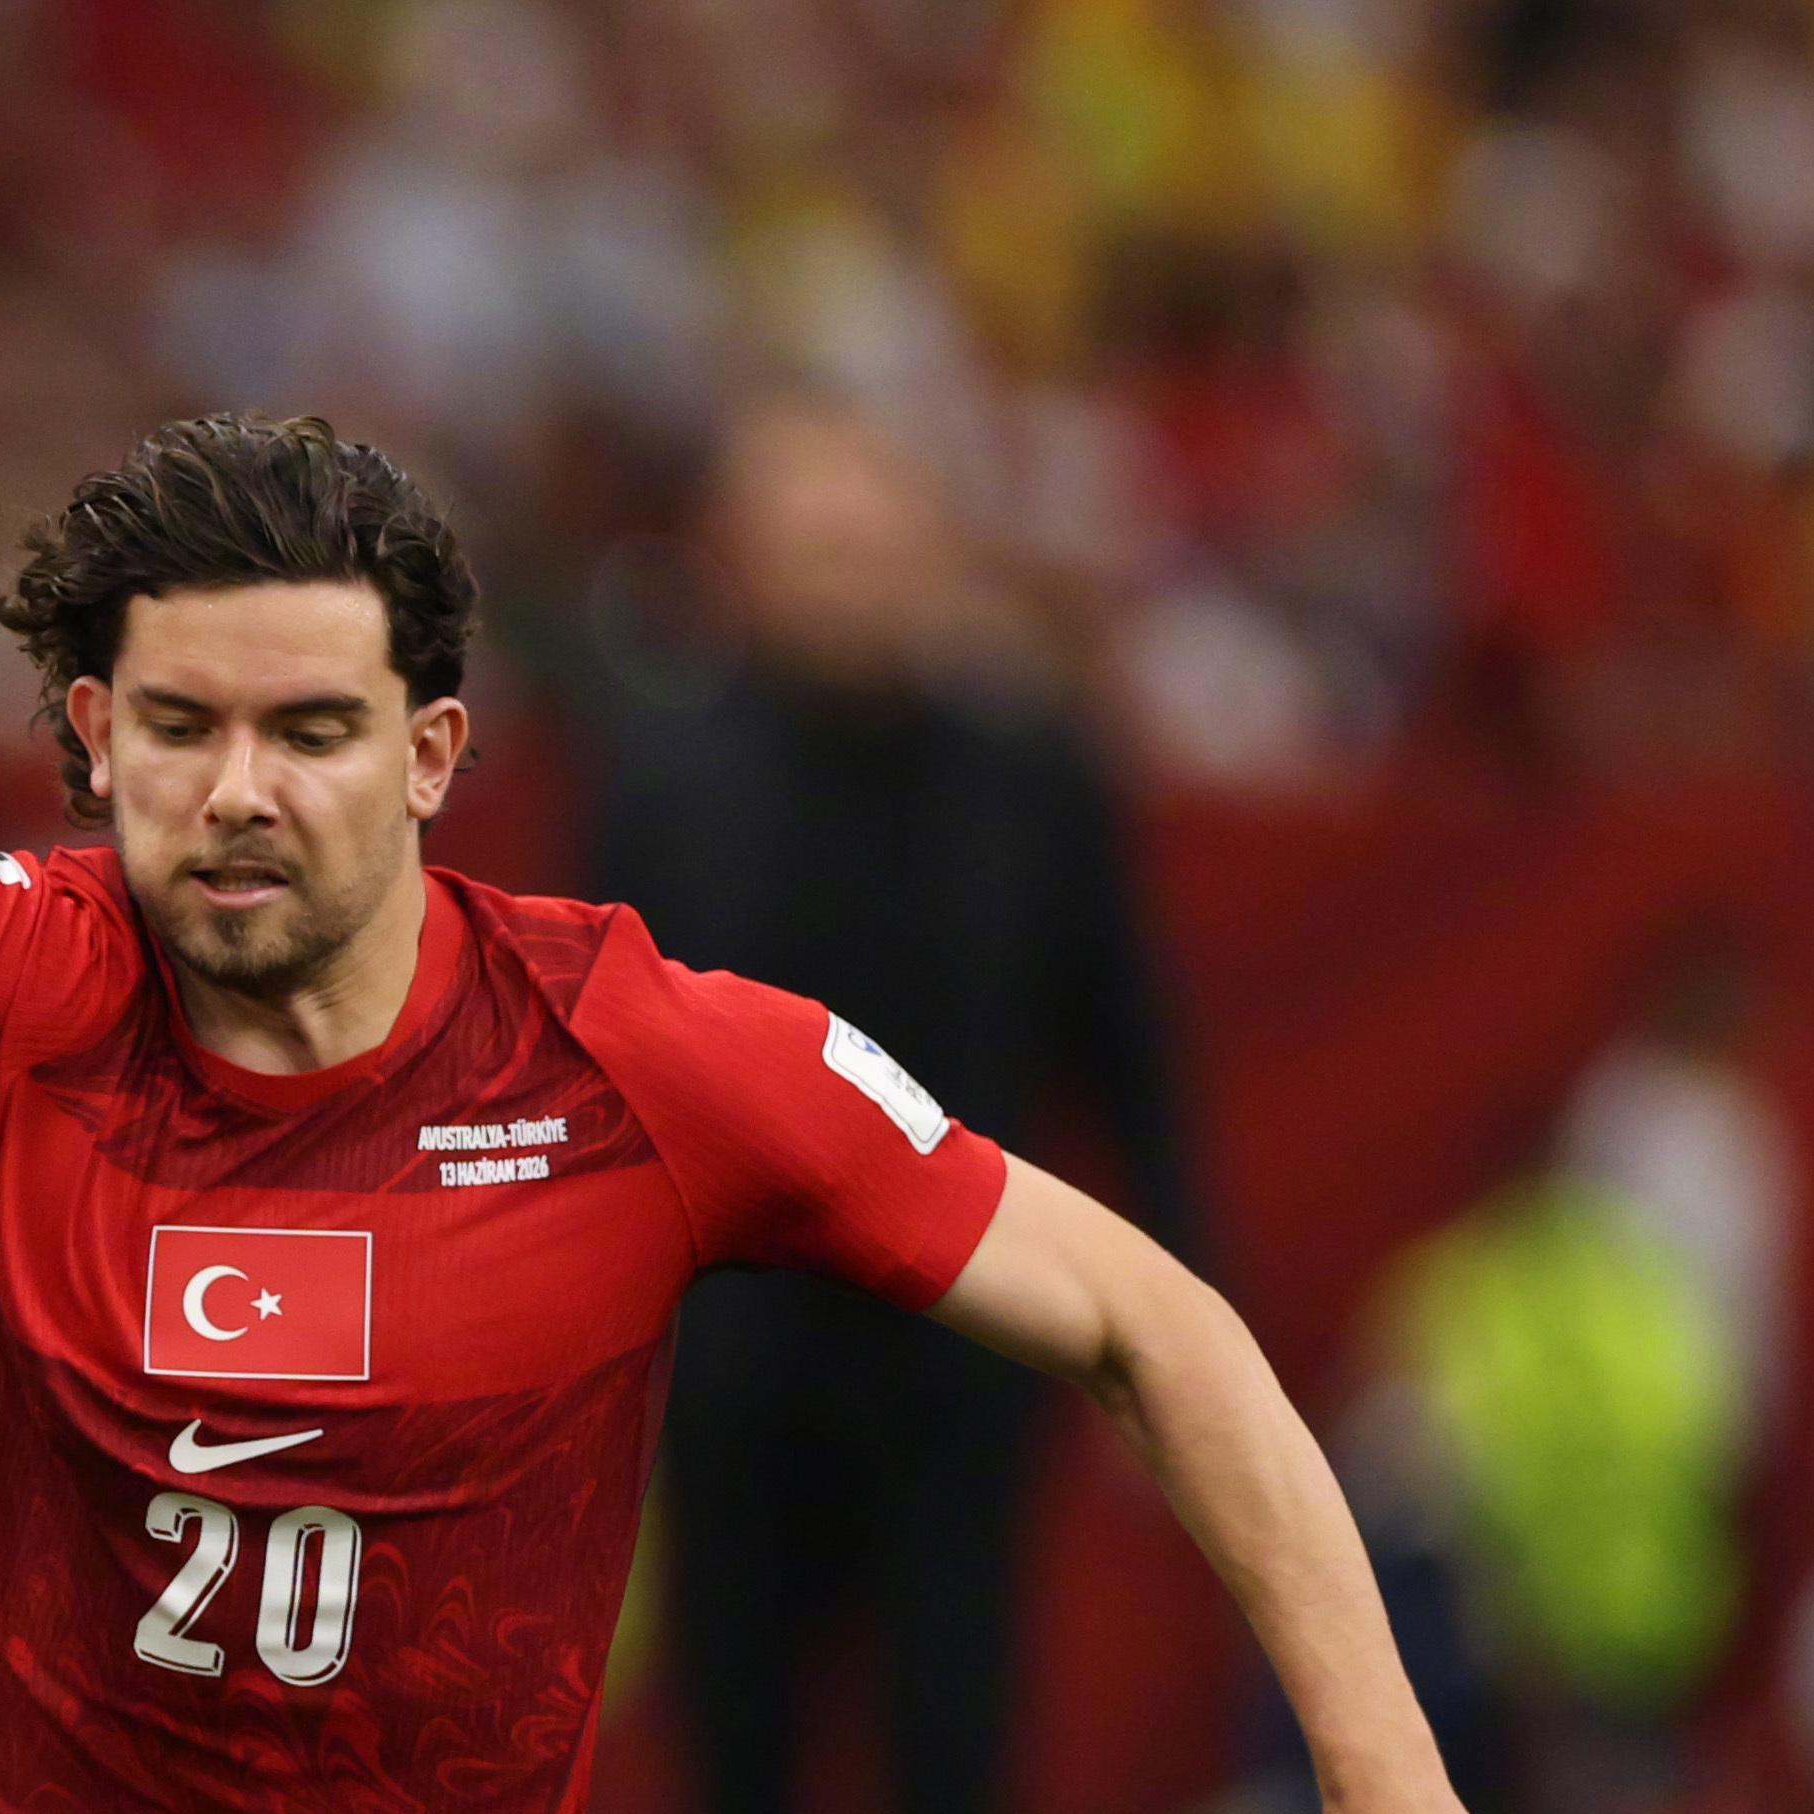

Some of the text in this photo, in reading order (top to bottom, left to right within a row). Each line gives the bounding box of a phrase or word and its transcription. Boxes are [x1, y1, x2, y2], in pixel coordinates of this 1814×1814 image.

[439, 1155, 549, 1186] 13 HAZİRAN 2026
[133, 1491, 362, 1687] 20
